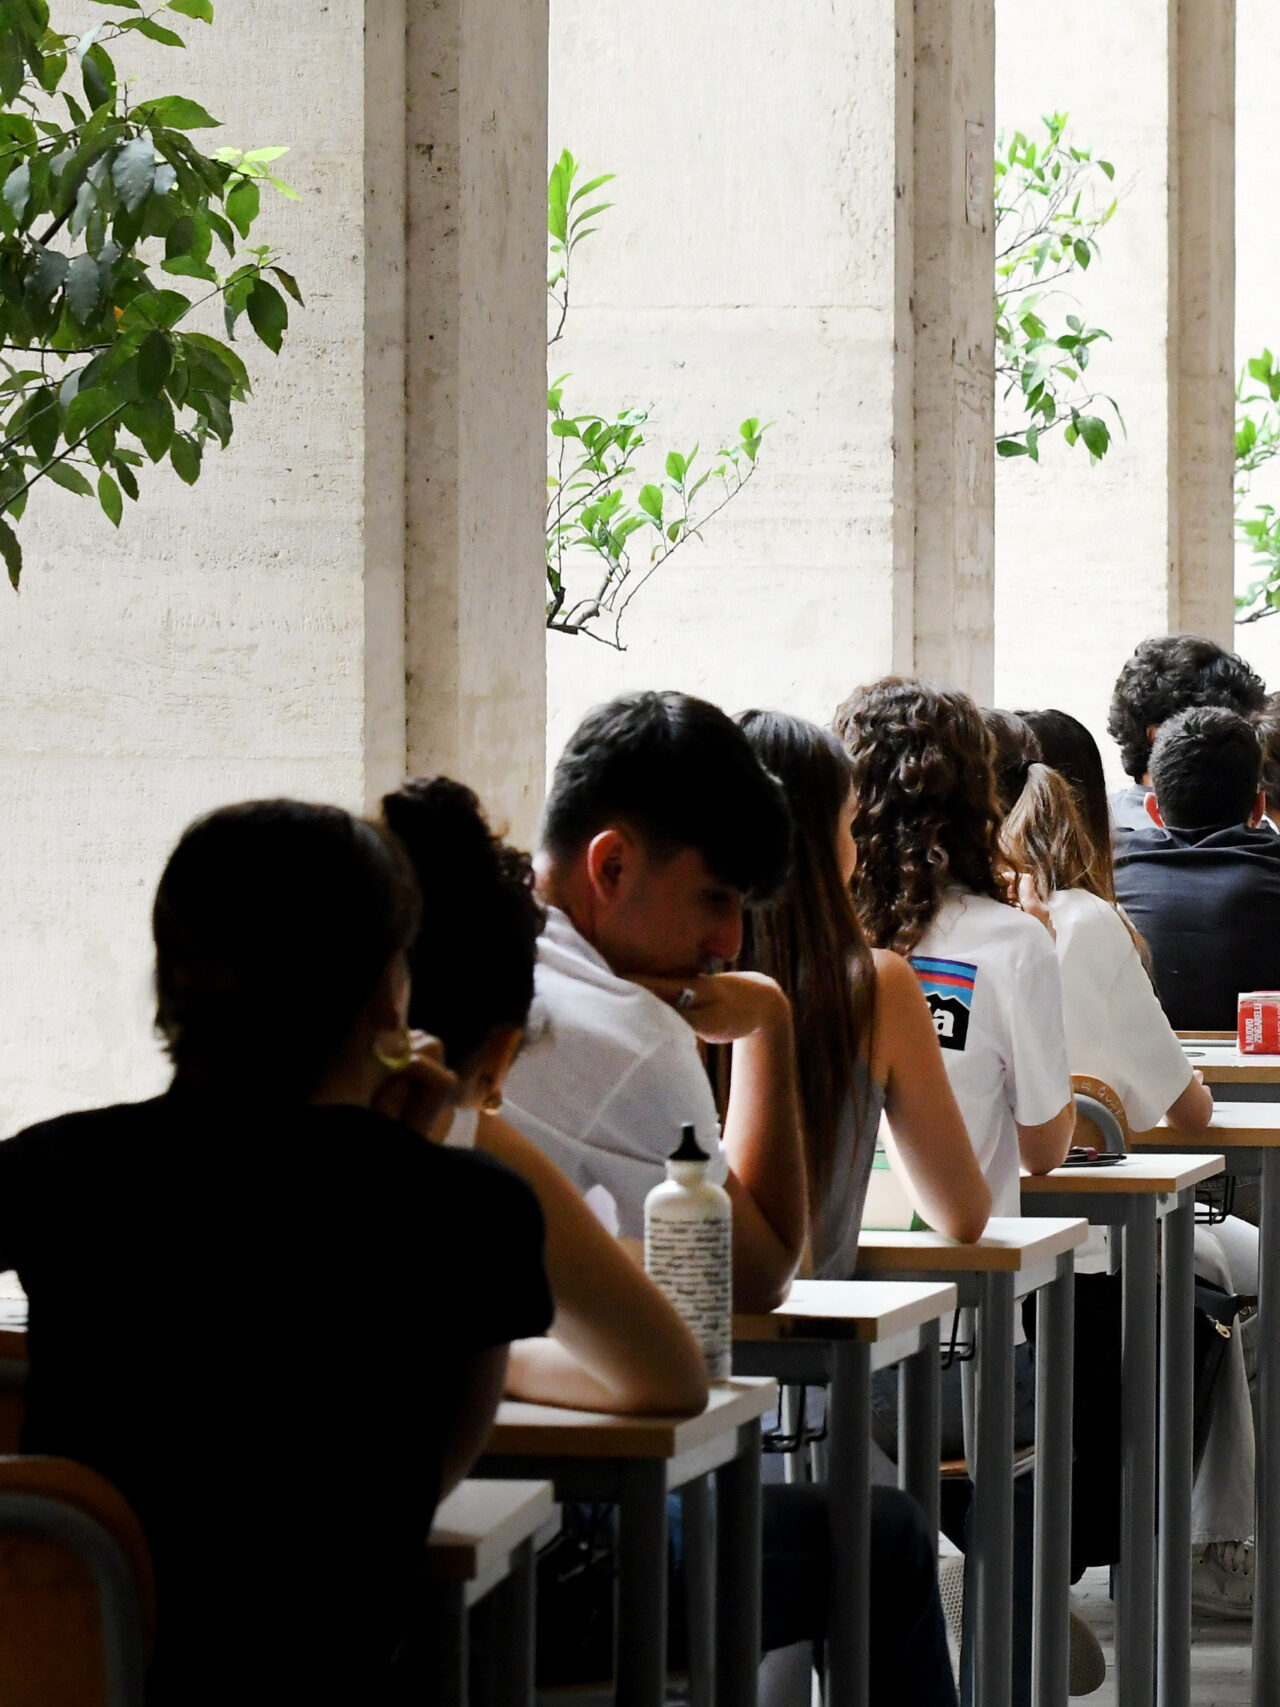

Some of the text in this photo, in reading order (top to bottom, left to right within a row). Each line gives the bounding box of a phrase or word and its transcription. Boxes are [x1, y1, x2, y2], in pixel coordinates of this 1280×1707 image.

[926, 1001, 955, 1038] a
[1245, 1018, 1254, 1043] NUOVO
[1253, 1003, 1263, 1044] ZINGARELLI
